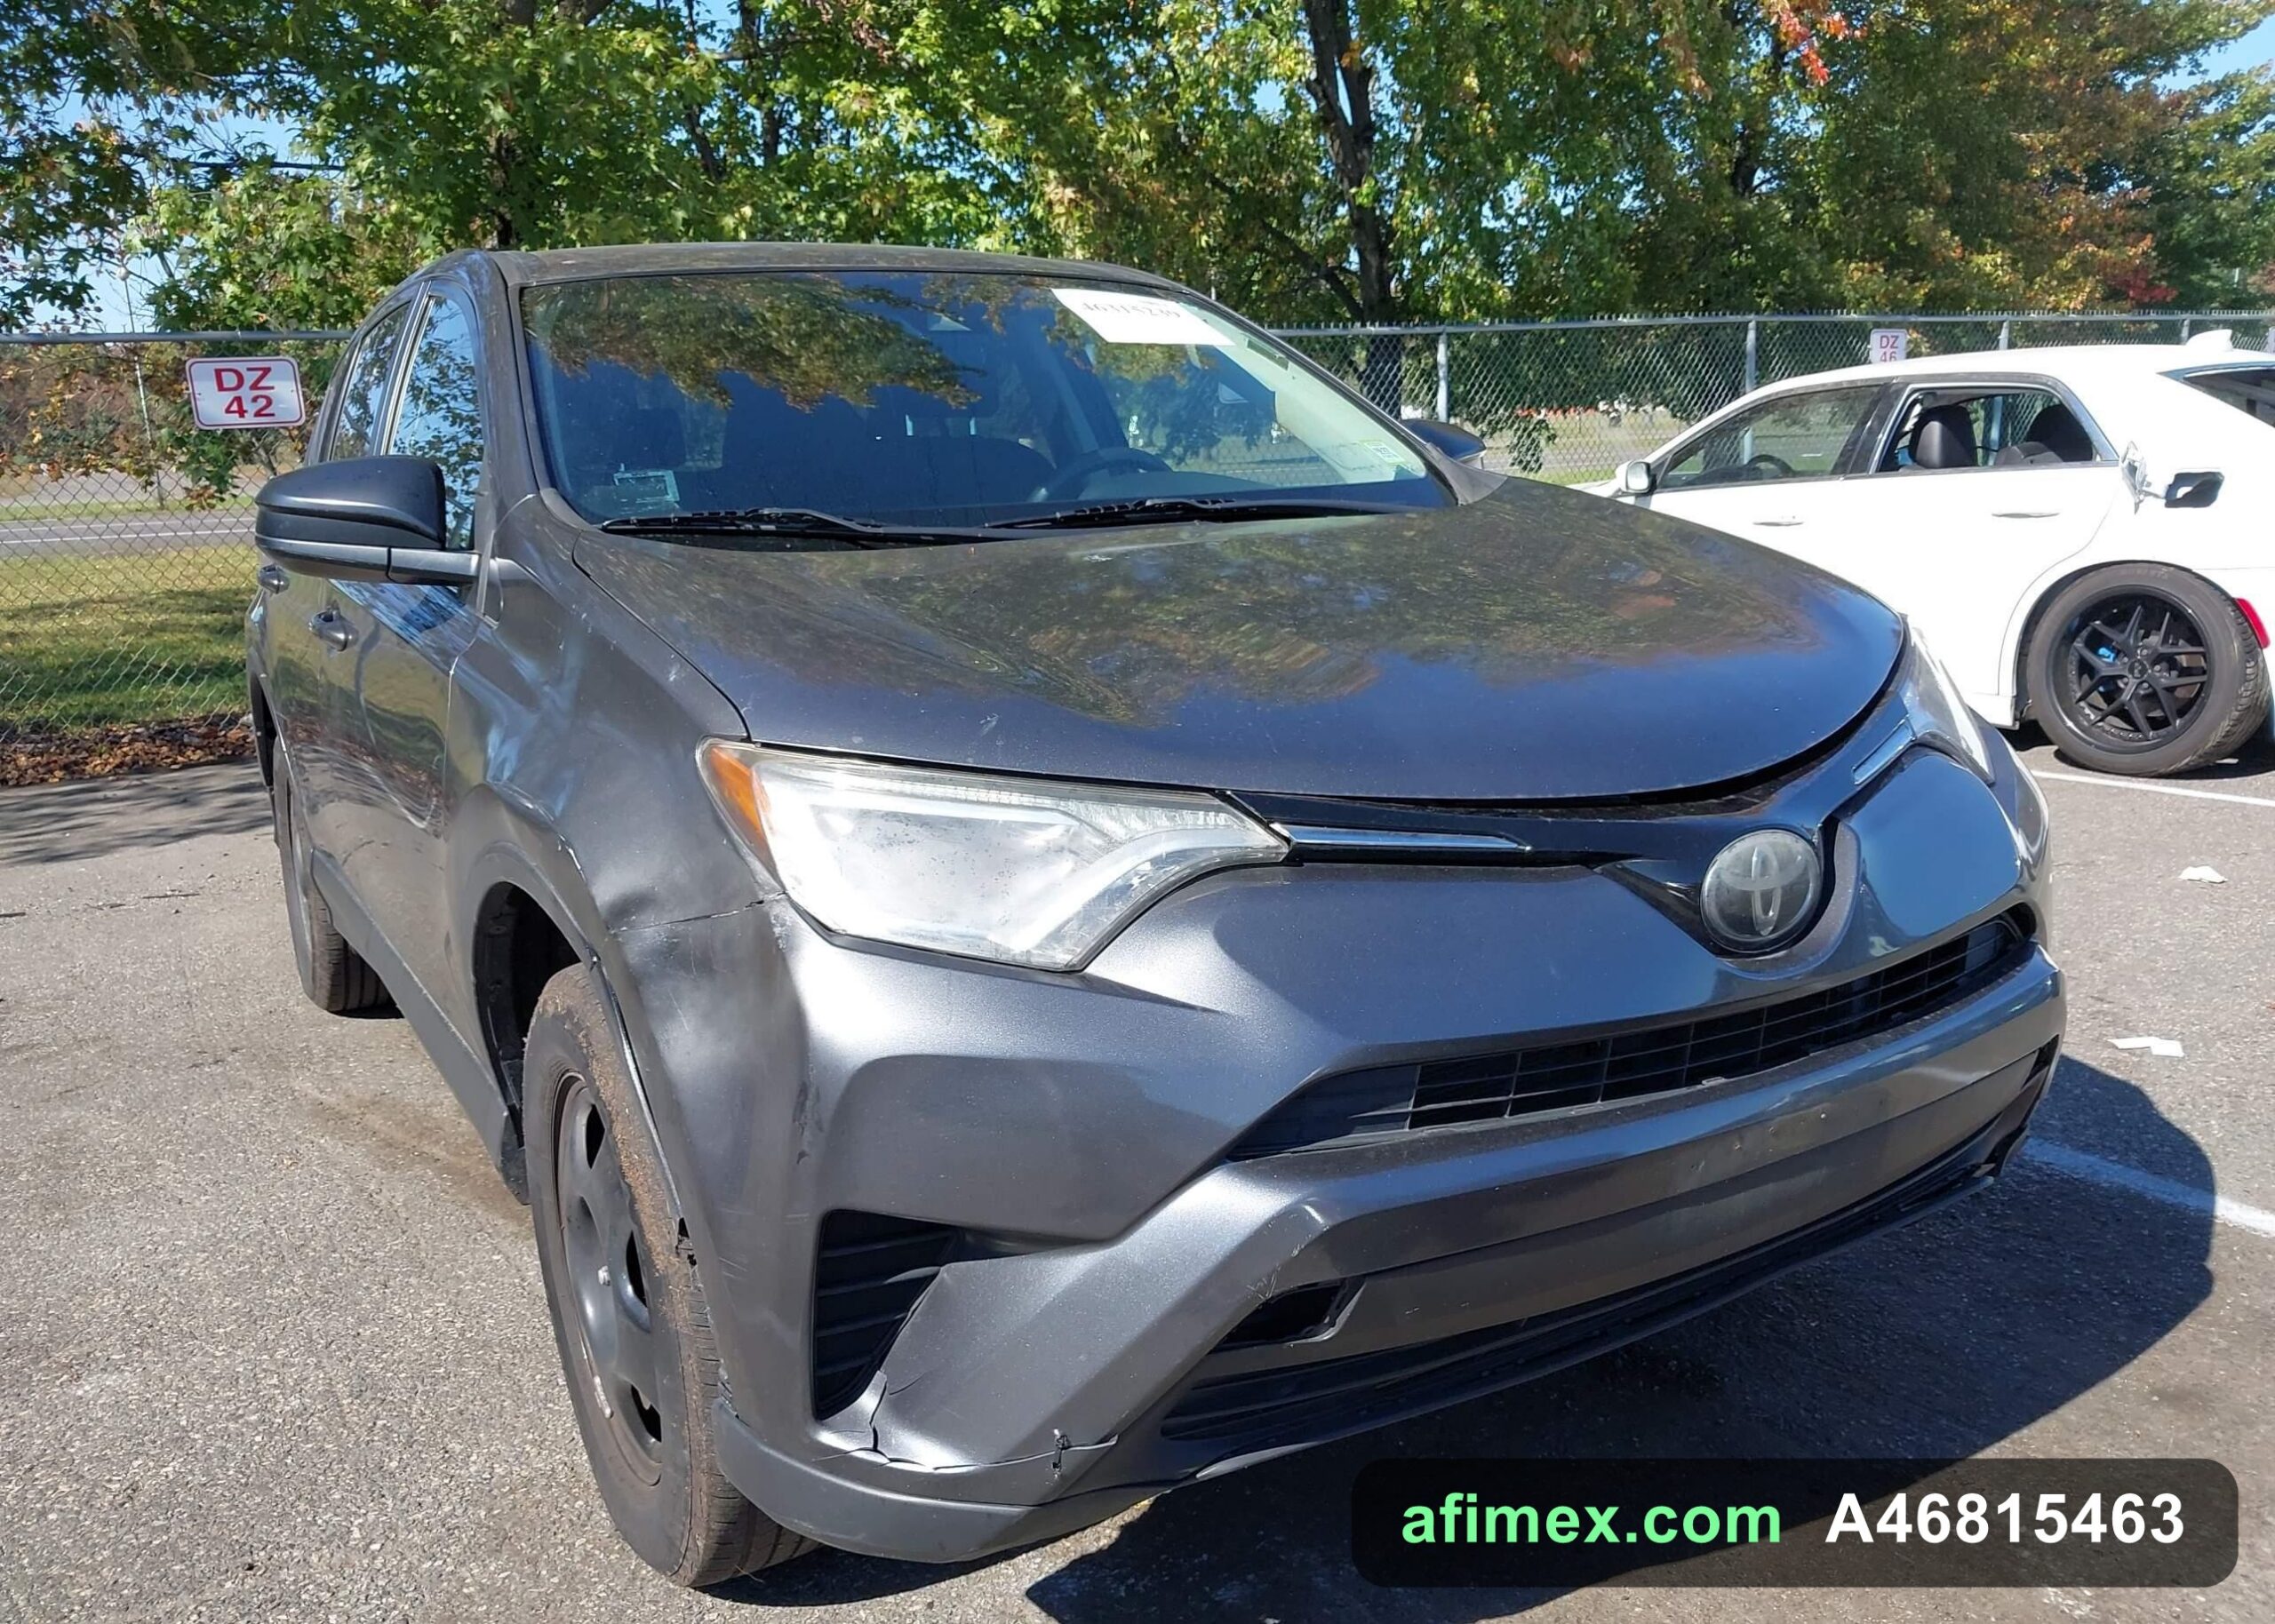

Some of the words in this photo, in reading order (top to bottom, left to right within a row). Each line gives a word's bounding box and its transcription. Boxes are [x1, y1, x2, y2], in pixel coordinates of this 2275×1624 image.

[1880, 335, 1900, 349] DZ
[214, 367, 275, 393] DZ
[224, 394, 275, 418] 42
